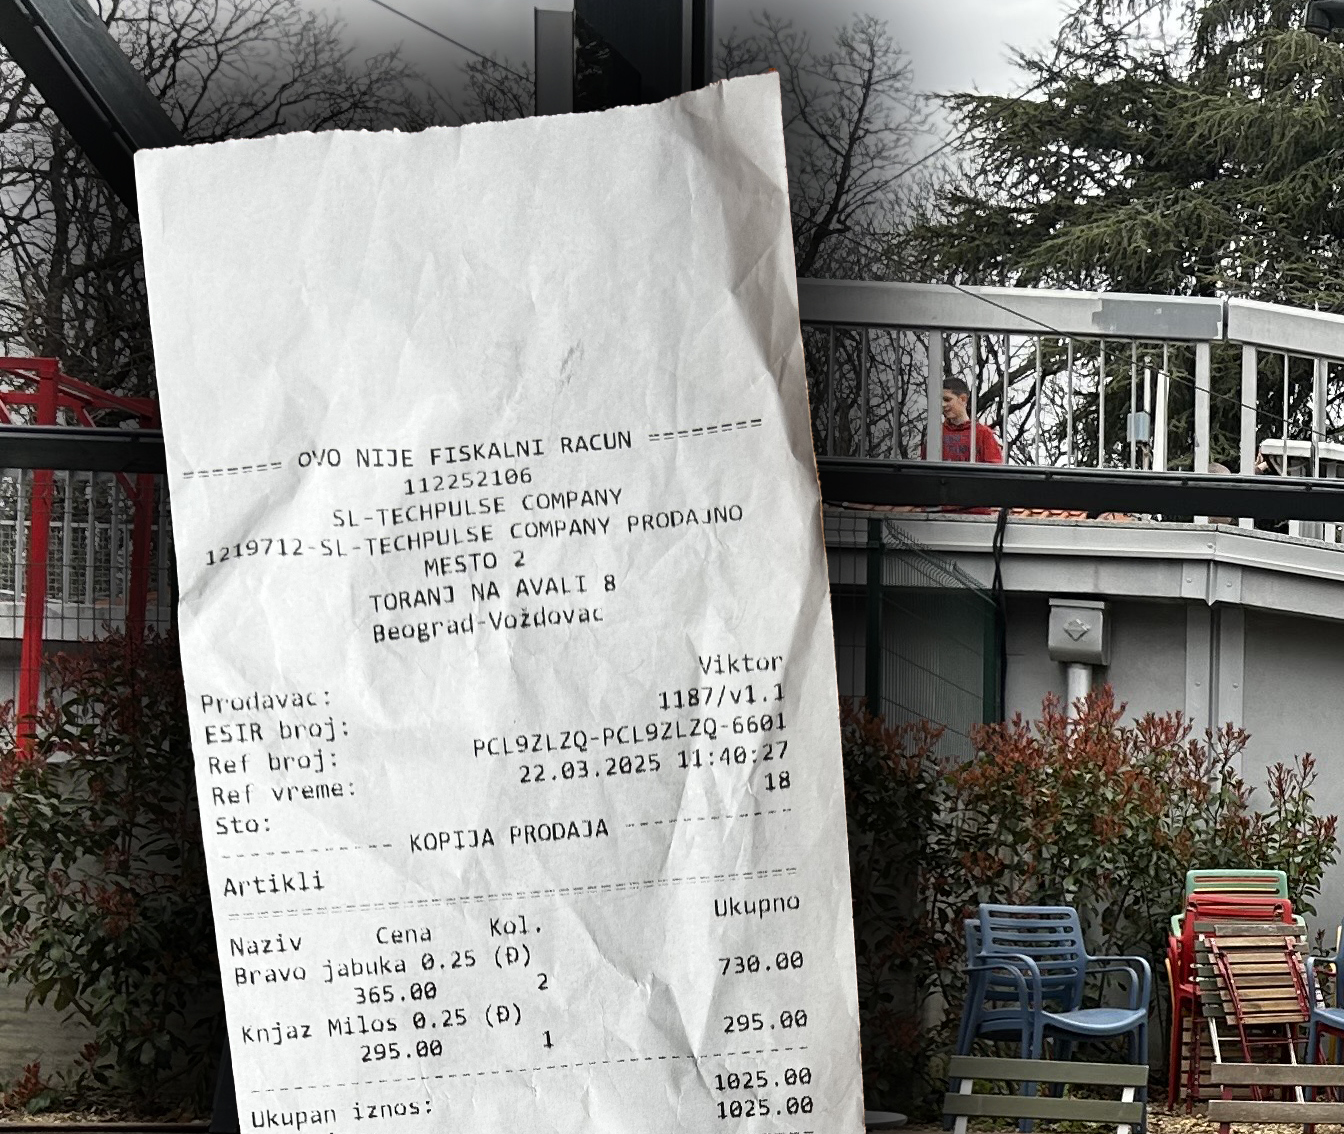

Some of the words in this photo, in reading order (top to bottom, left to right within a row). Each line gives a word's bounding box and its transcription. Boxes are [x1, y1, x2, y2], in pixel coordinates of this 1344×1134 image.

[297, 448, 342, 469] OVO
[356, 448, 414, 468] NIJE
[429, 438, 545, 466] FISKALNI
[560, 430, 632, 455] RACUN
[403, 466, 533, 496] 112252106
[332, 496, 506, 528] SL-TECHPULSE
[521, 487, 623, 511] COMPANY
[205, 524, 494, 568] 1219712-SL-TECHPULSE
[509, 516, 611, 540] COMPANY
[627, 504, 743, 534] PRODAJNO
[423, 551, 498, 579] MESTO
[512, 549, 526, 569] 2
[368, 584, 455, 614] TORANJ
[470, 580, 501, 603] NA
[515, 574, 588, 599] AVALI
[603, 573, 617, 593] 8
[372, 605, 604, 645] Beograd-Voždovac
[200, 690, 331, 715] Prodavac:
[698, 653, 783, 676] Viktor
[204, 721, 264, 746] ESIR
[279, 716, 349, 743] broj:
[658, 682, 786, 712] 1187/v1.1
[208, 753, 252, 775] Ref
[267, 748, 337, 774] broj:
[472, 711, 789, 759] PCL9ZLZQ-PCL9ZLZQ-6601
[211, 783, 256, 807] Ref
[270, 781, 355, 803] vreme:
[518, 752, 661, 785] 22.03.2025
[677, 739, 788, 770] 11:40:27
[215, 815, 271, 836] Sto:
[764, 770, 791, 793] 18
[409, 827, 495, 854] KOPIJA
[509, 818, 609, 846] PRODAJA
[223, 869, 325, 898] Artikli
[229, 933, 302, 958] Naziv
[375, 926, 432, 945] Cena
[489, 914, 542, 938] Kol.
[713, 894, 800, 921] Ukupno
[234, 966, 307, 988] Bravo
[322, 955, 407, 985] jabuka
[421, 948, 477, 971] 0.25
[353, 980, 438, 1005] 365.00
[536, 972, 549, 992] 2
[718, 950, 804, 977] 730.00
[241, 1021, 313, 1046] Knjaz
[327, 1014, 398, 1038] Milos
[412, 1007, 468, 1031] 0.25
[359, 1039, 443, 1064] 295.00
[541, 1030, 555, 1050] 1
[723, 1008, 808, 1035] 295.00
[251, 1108, 337, 1132] Ukupan
[352, 1100, 432, 1122] iznos:
[714, 1066, 812, 1093] 1025.00
[716, 1095, 814, 1121] 1025.00
